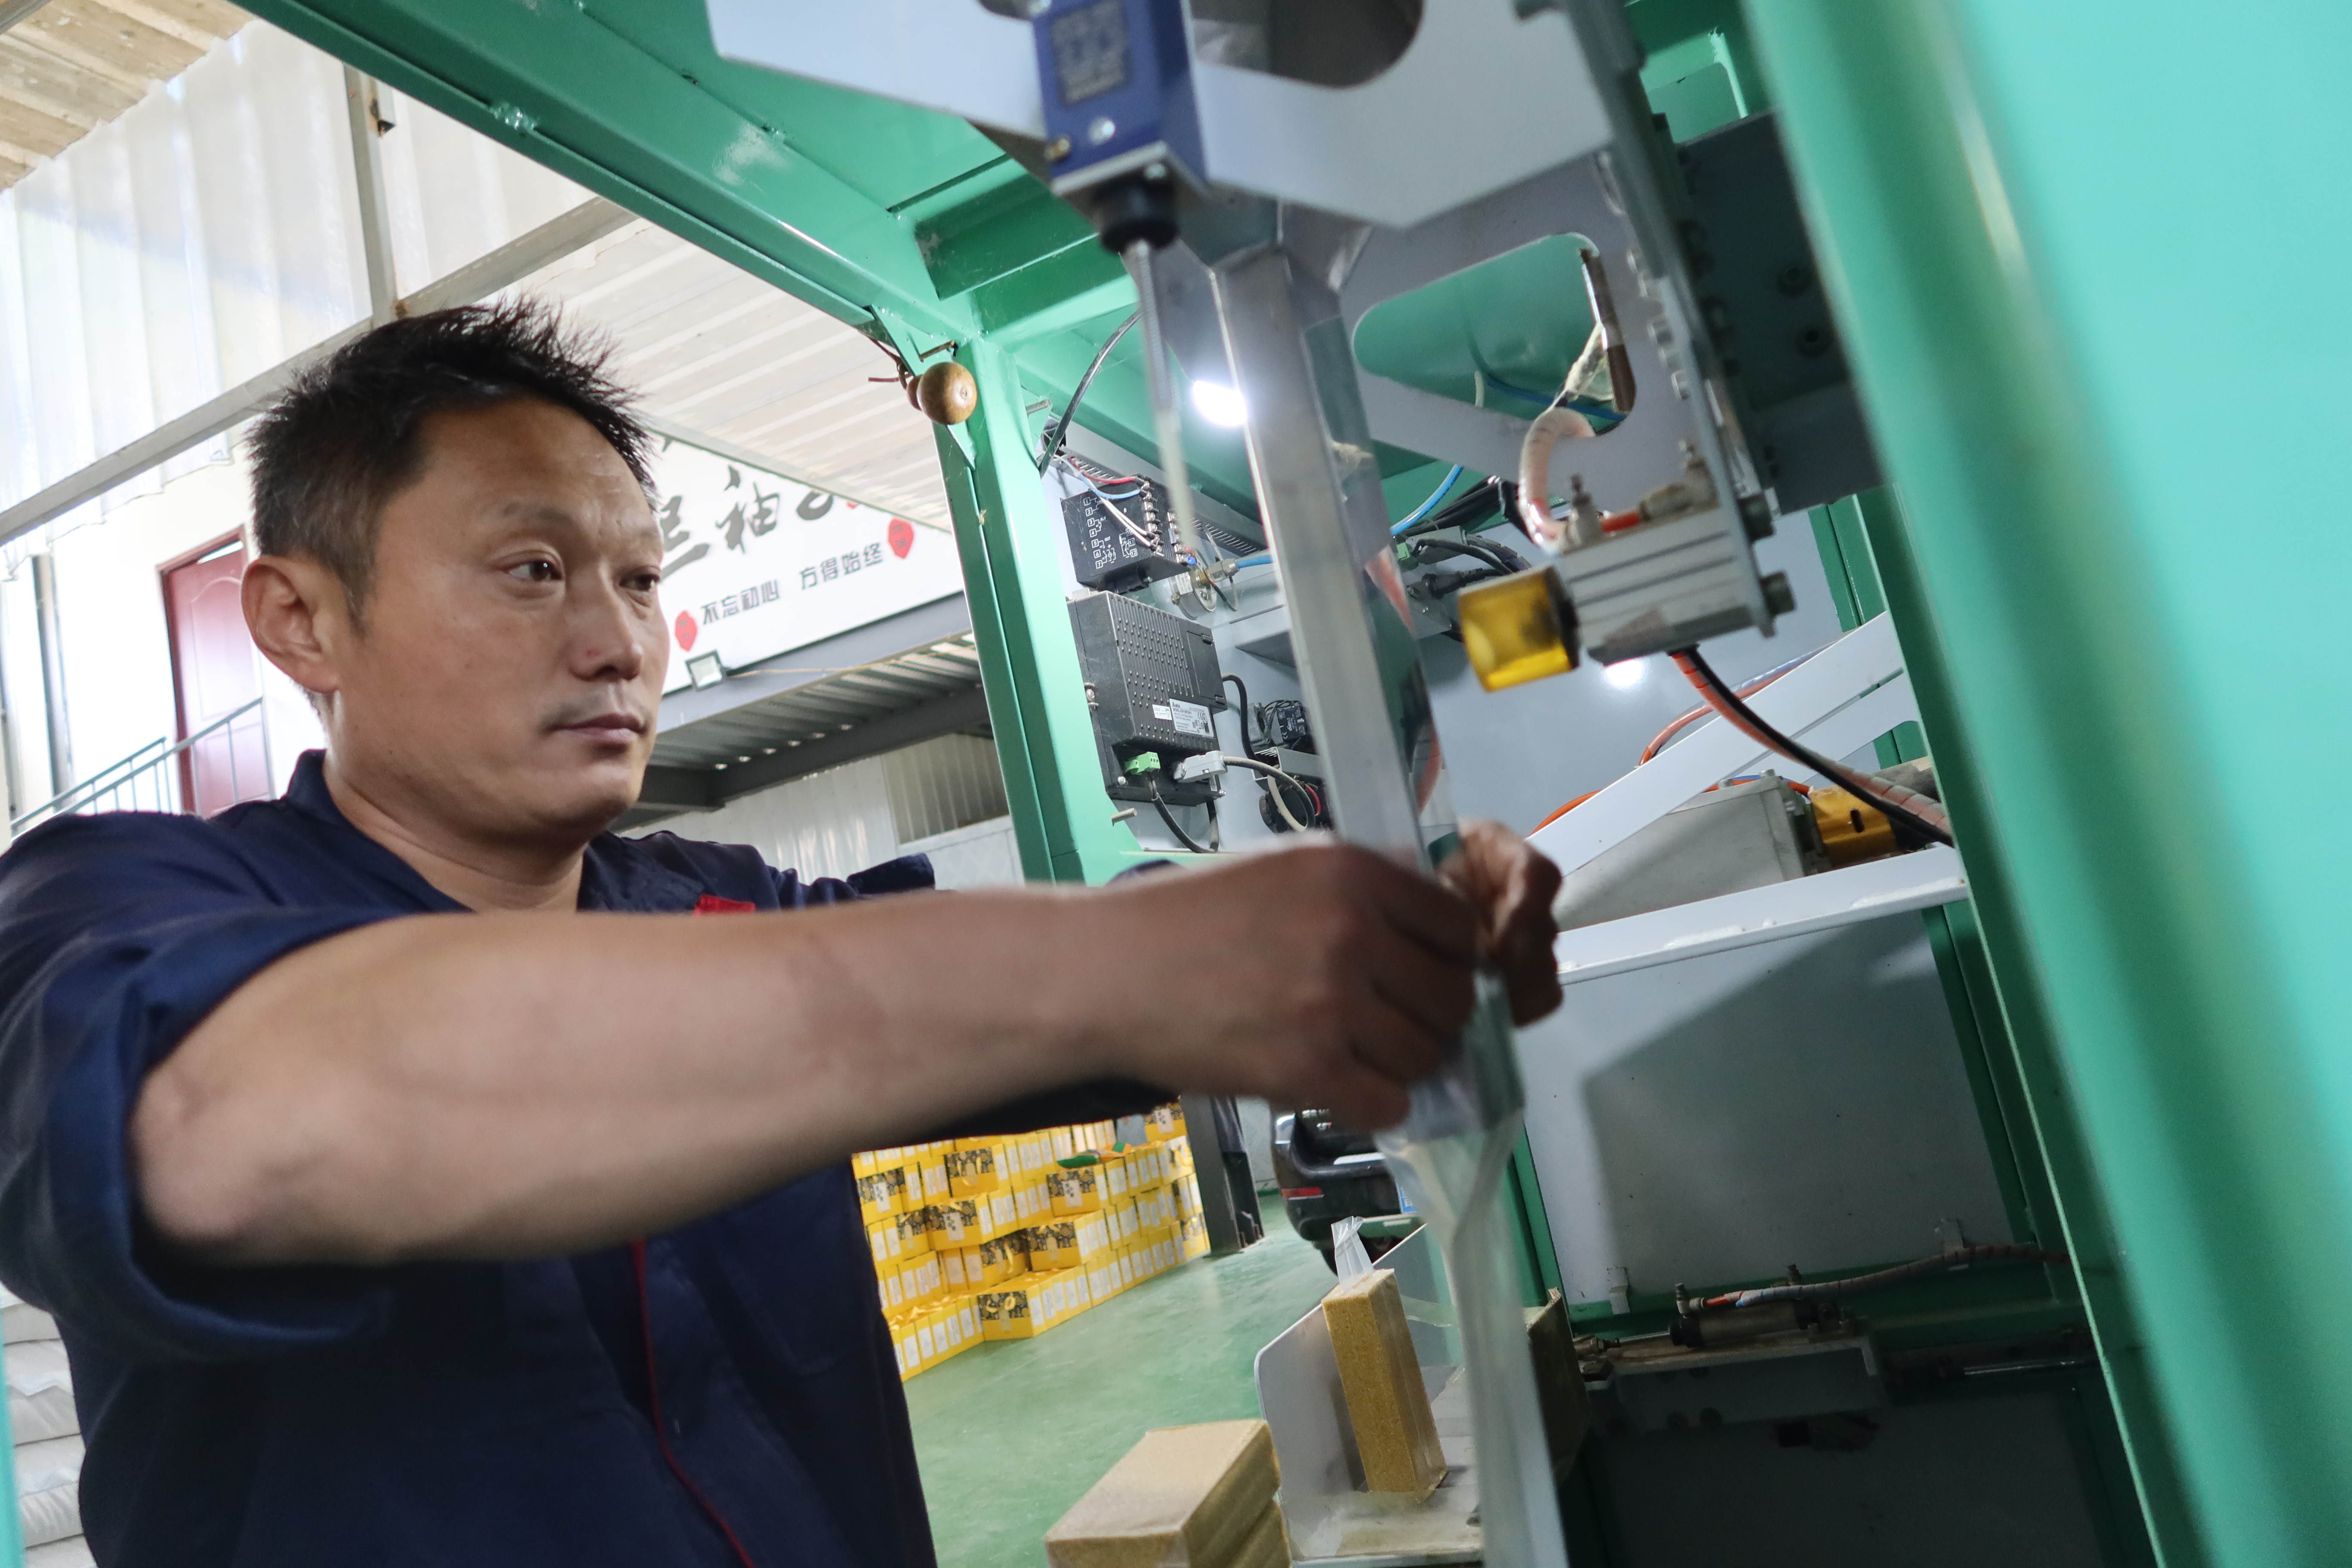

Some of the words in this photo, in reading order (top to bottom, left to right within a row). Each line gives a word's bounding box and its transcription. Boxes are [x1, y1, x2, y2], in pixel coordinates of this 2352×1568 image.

[701, 579, 780, 625] 不忘初心
[799, 542, 884, 590] 方得始终
